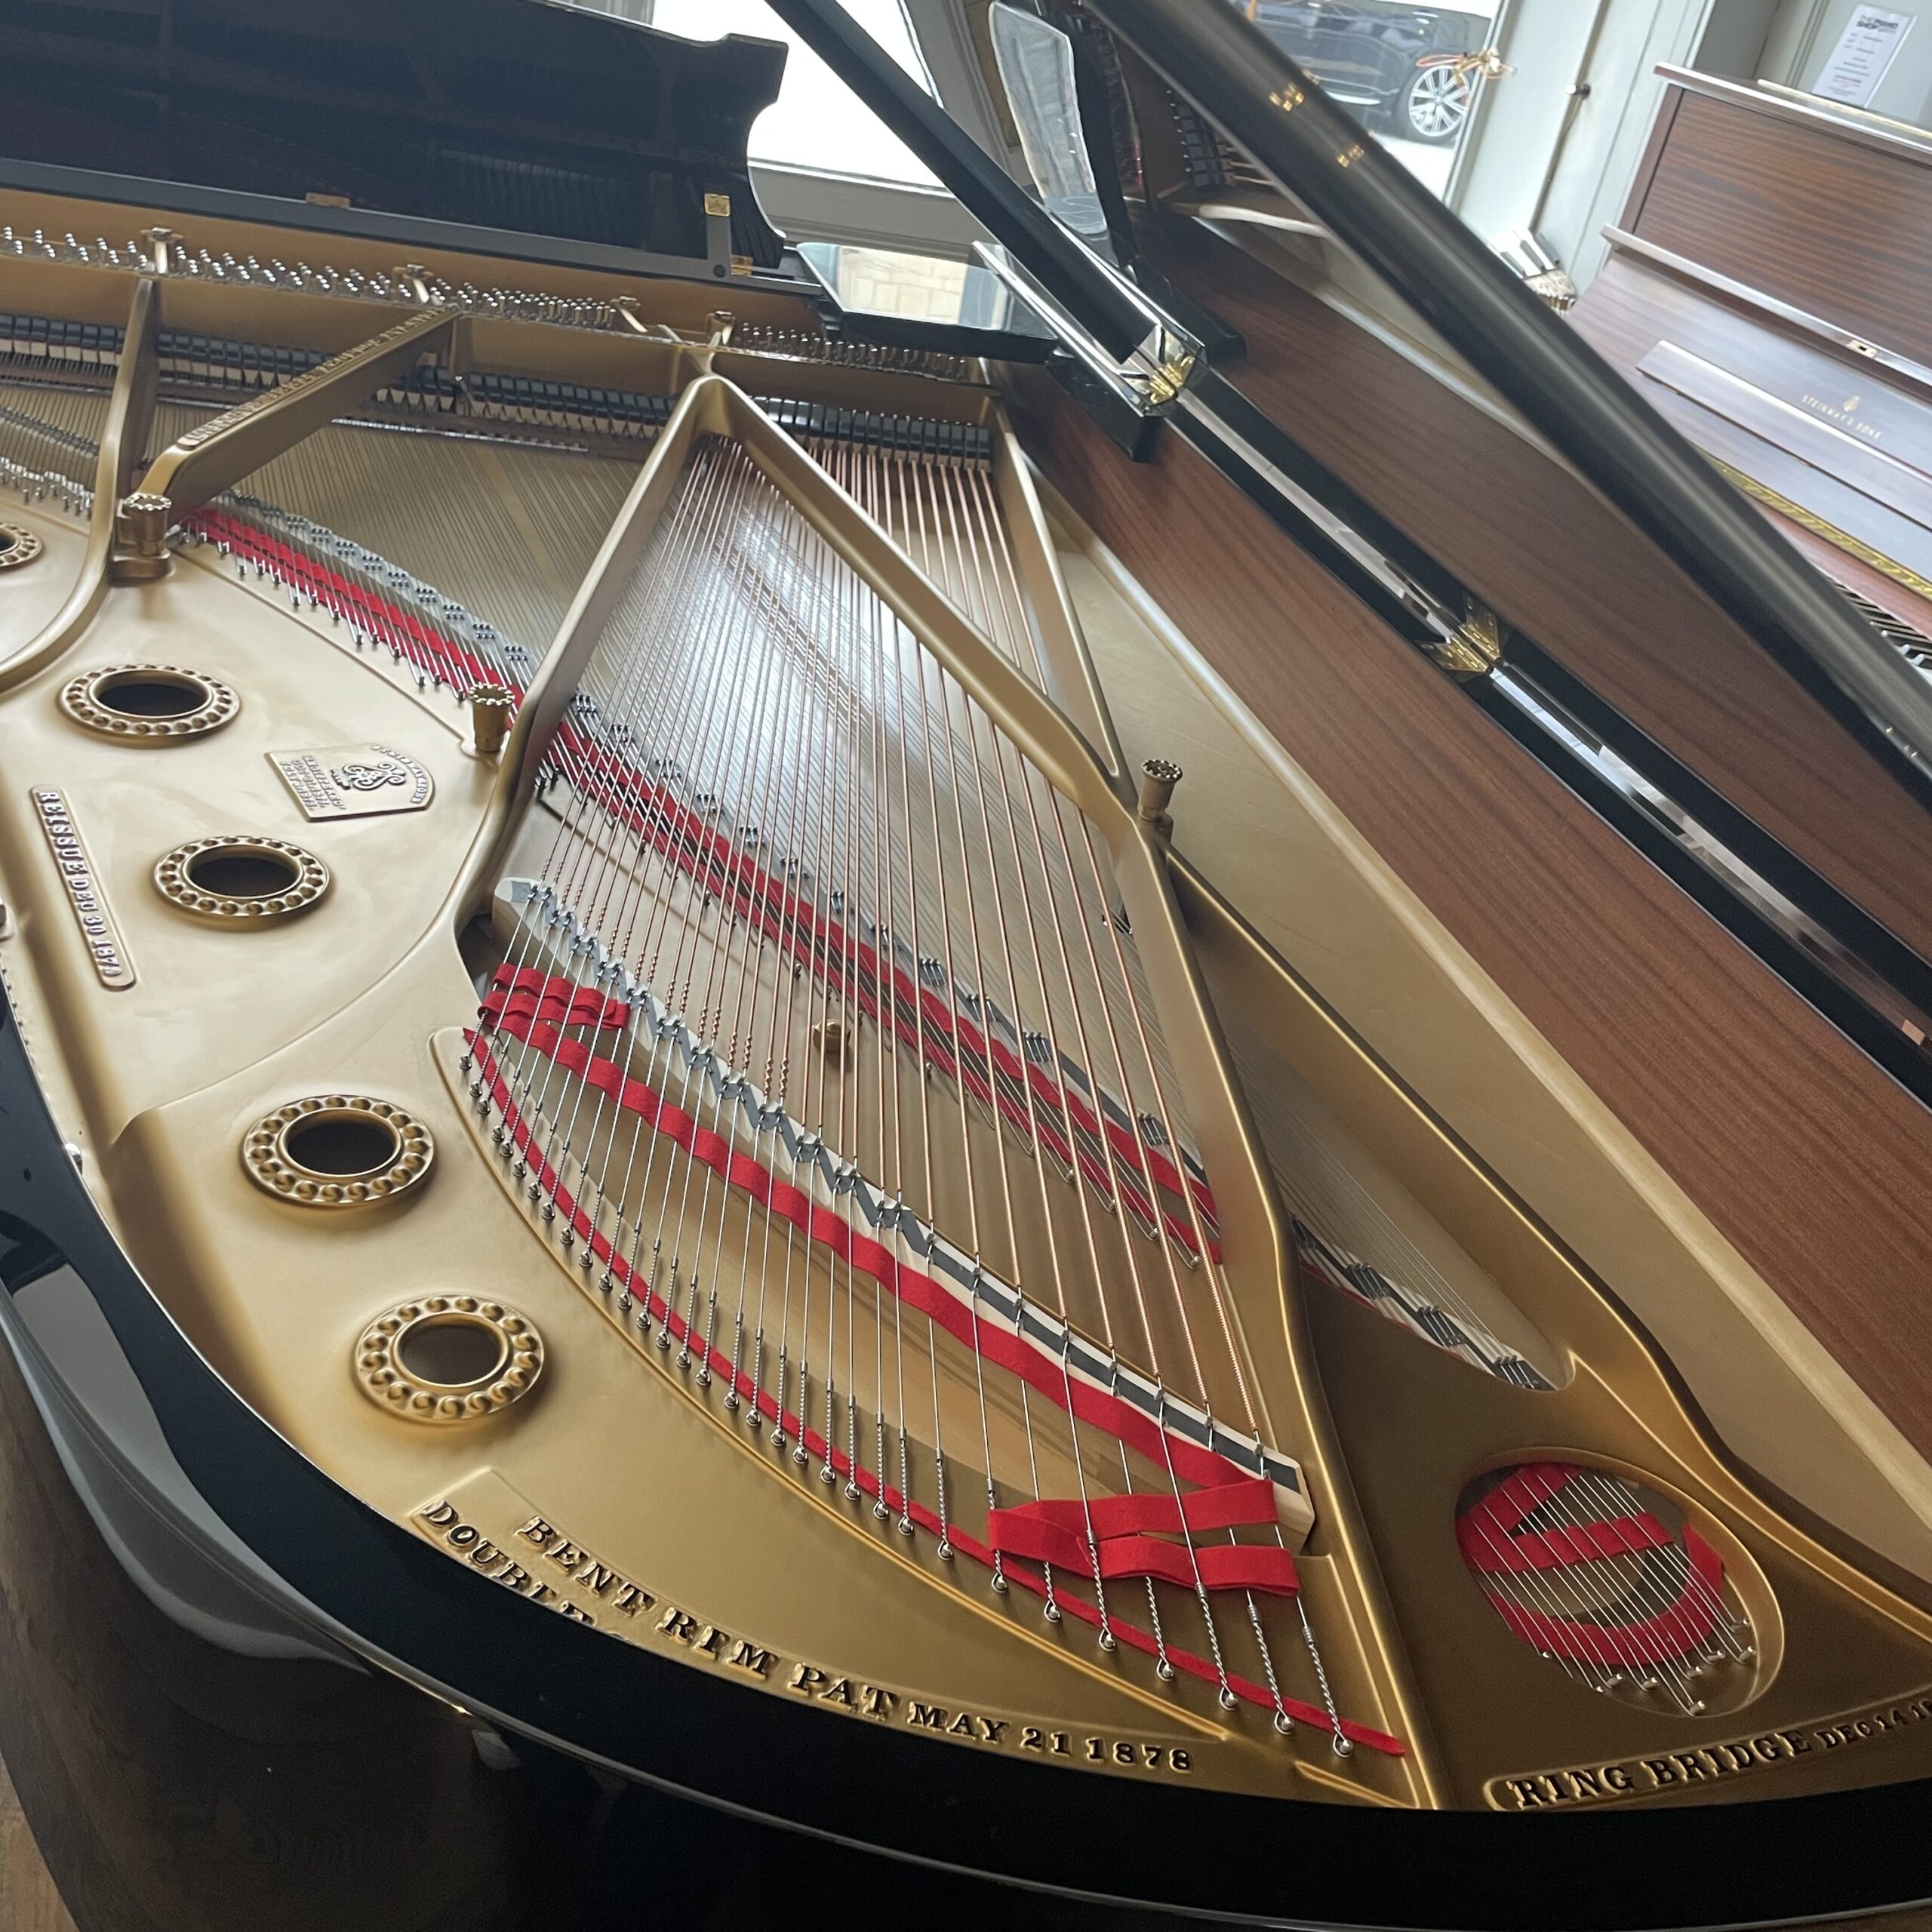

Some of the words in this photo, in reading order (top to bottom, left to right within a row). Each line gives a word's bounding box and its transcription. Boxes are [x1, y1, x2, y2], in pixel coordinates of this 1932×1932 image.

[38, 792, 88, 875] REISSUE
[69, 879, 99, 912] DEC
[84, 915, 107, 936] 30
[516, 1515, 657, 1617] BENT
[655, 1606, 780, 1681] RIM
[787, 1663, 903, 1721] PAT
[907, 1701, 1008, 1744] MAY
[1020, 1727, 1072, 1757] 21
[1085, 1737, 1192, 1774] 1878
[1509, 1764, 1634, 1809] RING
[1641, 1729, 1813, 1789] BRIDGE
[1814, 1720, 1872, 1749] DEC
[1873, 1708, 1909, 1731] 14
